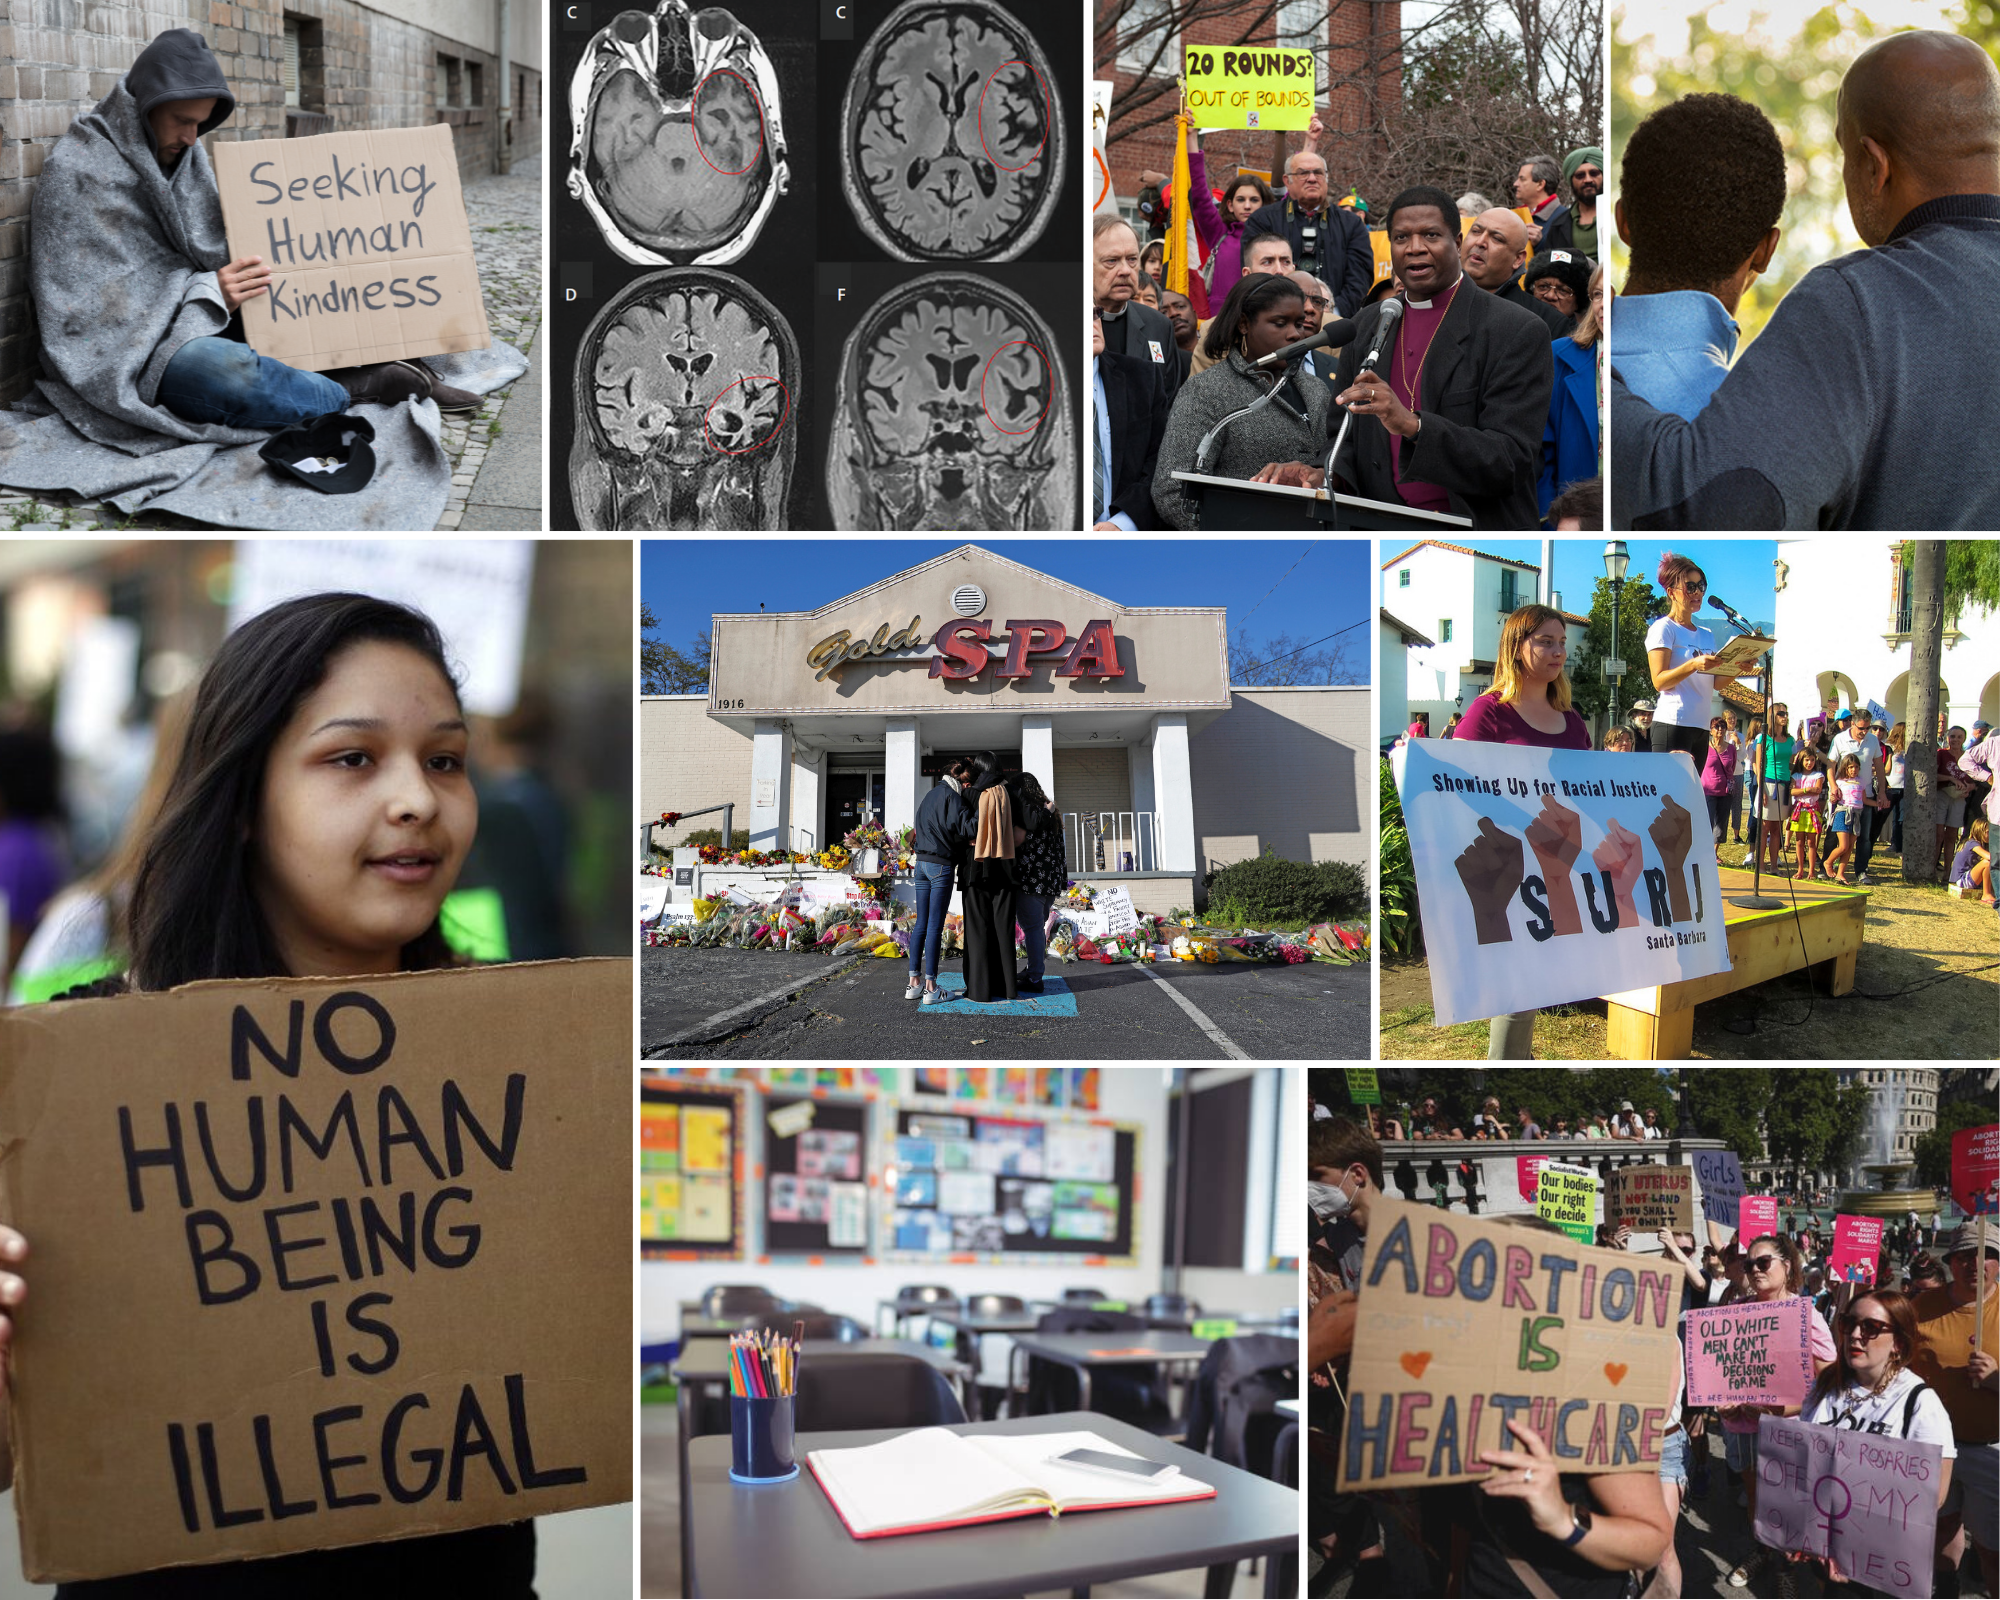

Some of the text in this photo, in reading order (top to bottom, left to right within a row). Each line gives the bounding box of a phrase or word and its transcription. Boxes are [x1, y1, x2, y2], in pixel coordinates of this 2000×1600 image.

[1187, 51, 1313, 78] 20 ROUNDS?
[1189, 90, 1311, 108] OUT OF BOUNDS
[250, 153, 437, 218] Seeking
[267, 217, 423, 265] Human
[267, 275, 442, 323] Kindness
[807, 614, 1126, 682] Gold SPA
[718, 699, 745, 710] 1916
[1432, 773, 1658, 799] Showing Up for Racial Justice
[846, 892, 857, 900] Stop
[1107, 888, 1118, 896] NO
[1646, 930, 1706, 951] Santa Barbara
[231, 991, 396, 1081] NO
[117, 1073, 526, 1212] HUMAN
[1699, 1155, 1735, 1184] Girls
[1541, 1172, 1594, 1193] Our bodies
[1610, 1174, 1689, 1192] MY UTERUS
[1540, 1188, 1586, 1209] Our right
[1625, 1193, 1648, 1205] NOT
[1651, 1193, 1680, 1204] LAND
[1540, 1204, 1586, 1222] to decide
[1625, 1207, 1640, 1215] YOU
[1643, 1206, 1675, 1217] SHALL
[1705, 1195, 1730, 1224] FUN
[1638, 1217, 1658, 1226] OWN
[1661, 1217, 1677, 1227] IT
[1851, 1221, 1880, 1229] ABORTION
[1847, 1231, 1878, 1239] SOLIDARITY
[1857, 1237, 1878, 1245] MARCH
[185, 1187, 481, 1305] BEING
[1366, 1215, 1672, 1328] ABORTION
[1697, 1309, 1732, 1317] ABORTION
[1741, 1299, 1798, 1313] HEALTHCARE
[1700, 1316, 1779, 1338] OLD WHITE
[1800, 1298, 1808, 1348] PATRIARCHY
[311, 1291, 400, 1377] IS
[1518, 1316, 1565, 1372] IS
[1703, 1334, 1769, 1354] MEN CAN'T
[1715, 1348, 1768, 1366] MAKE MY
[1801, 1352, 1810, 1371] THE
[1723, 1364, 1776, 1378] DECISIONS
[1729, 1376, 1766, 1390] FOR ME
[1691, 1395, 1702, 1403] WE
[1344, 1392, 1666, 1483] HEALTHCARE
[167, 1373, 587, 1533] ILLEGAL
[1769, 1426, 1931, 1481] KEEP YOUR ROSARIES
[1763, 1459, 1919, 1532] OFF MY
